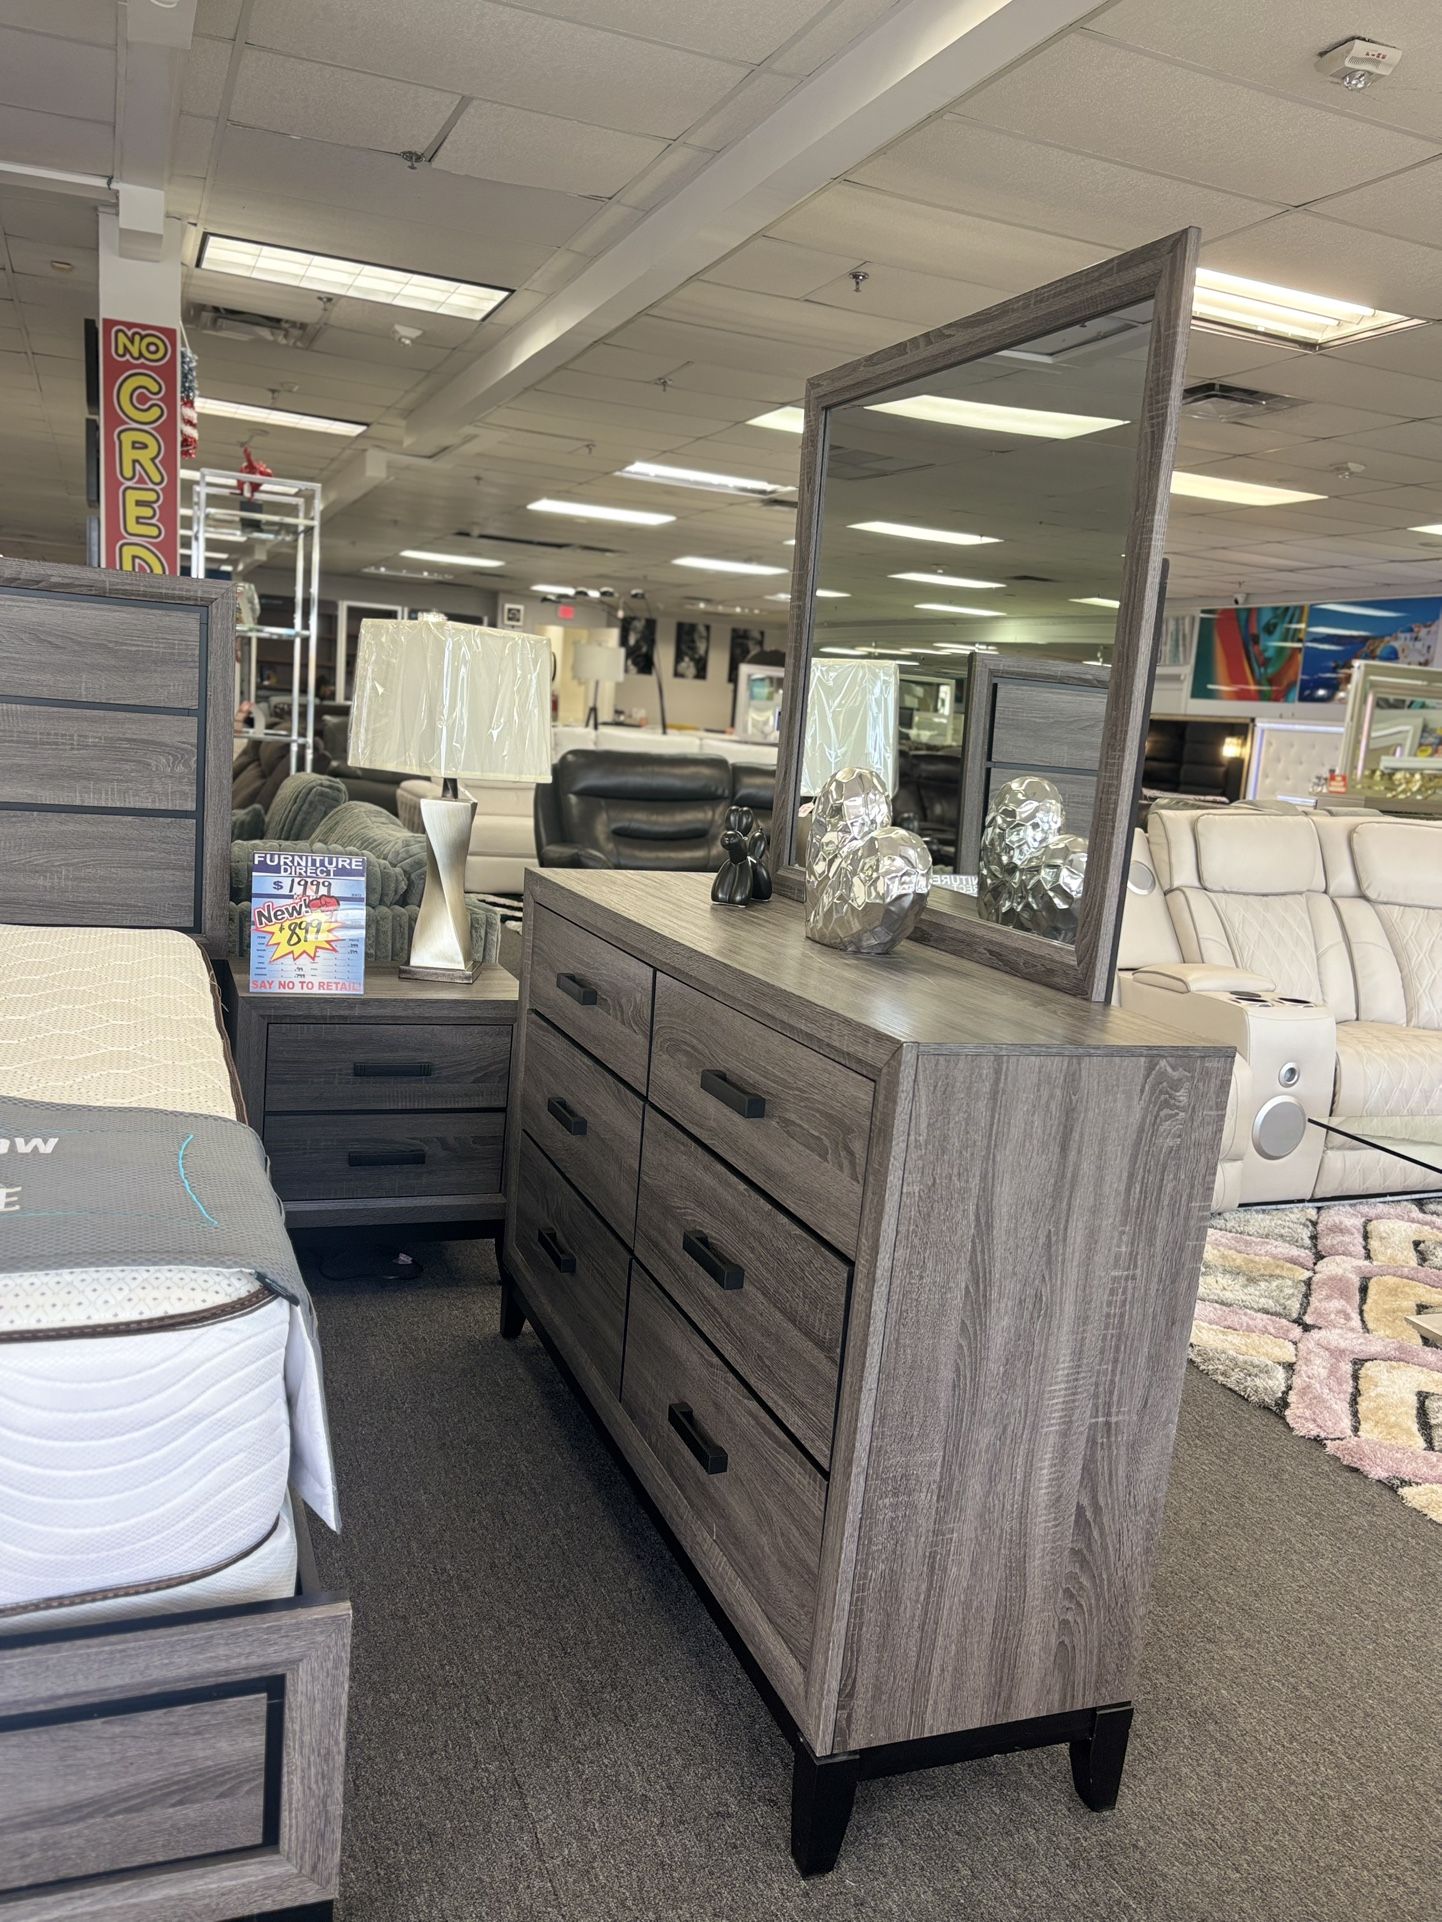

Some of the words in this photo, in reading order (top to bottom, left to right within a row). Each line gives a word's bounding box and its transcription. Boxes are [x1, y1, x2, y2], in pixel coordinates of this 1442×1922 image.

[115, 328, 168, 362] NO
[254, 853, 363, 869] FURNITURE
[281, 866, 337, 877] DIRECT
[256, 898, 310, 926] New!
[251, 980, 274, 990] SAY
[278, 980, 295, 990] NO
[299, 981, 314, 991] TO
